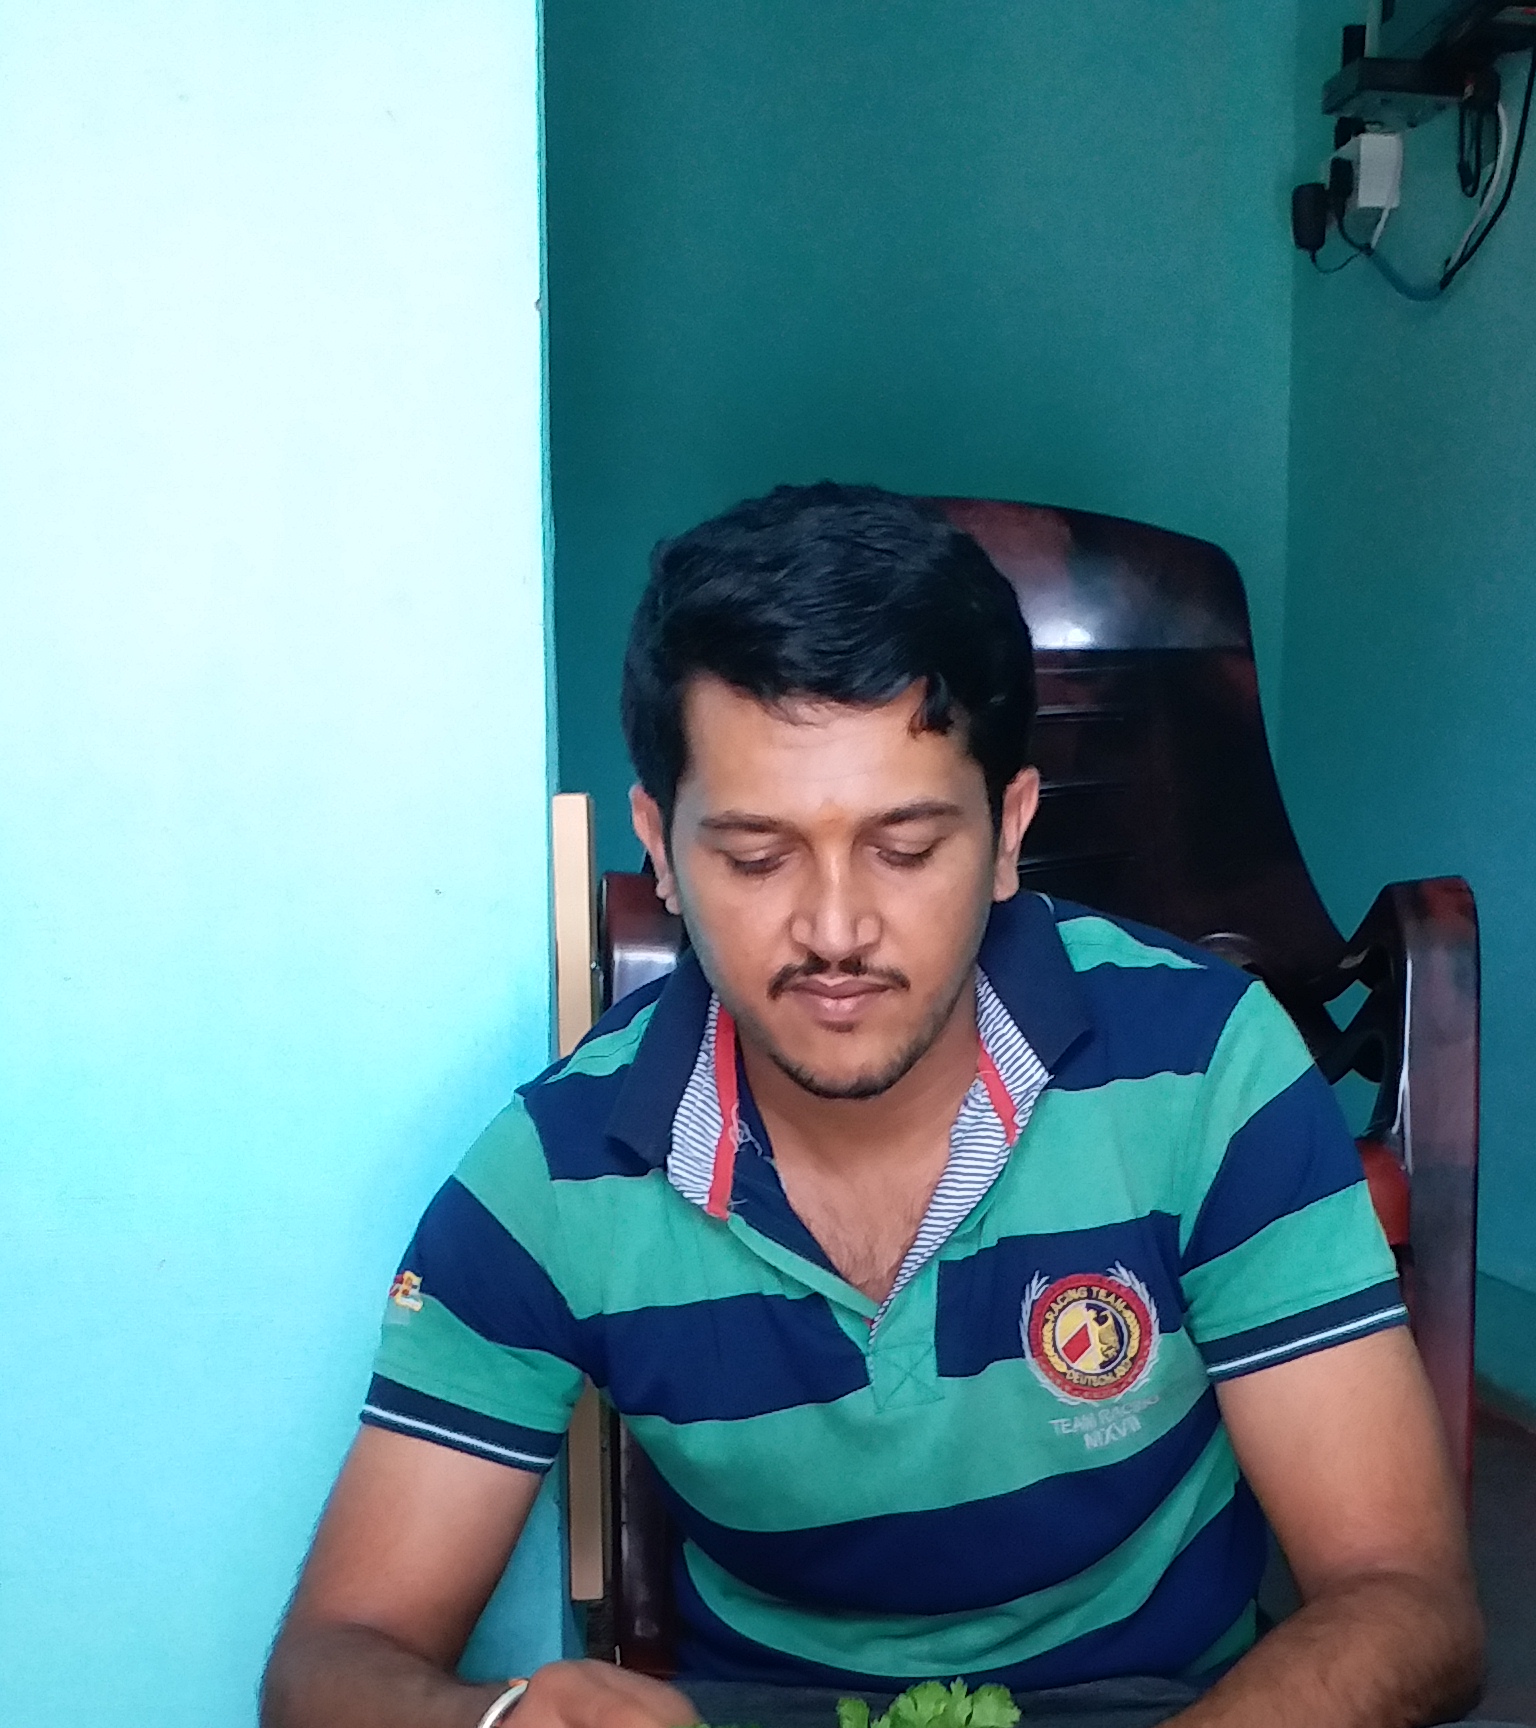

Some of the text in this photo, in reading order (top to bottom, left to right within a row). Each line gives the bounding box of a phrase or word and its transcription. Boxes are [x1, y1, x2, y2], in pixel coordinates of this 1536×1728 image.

[1045, 1286, 1128, 1323] RACING TEAM
[1049, 1412, 1096, 1436] TEAM
